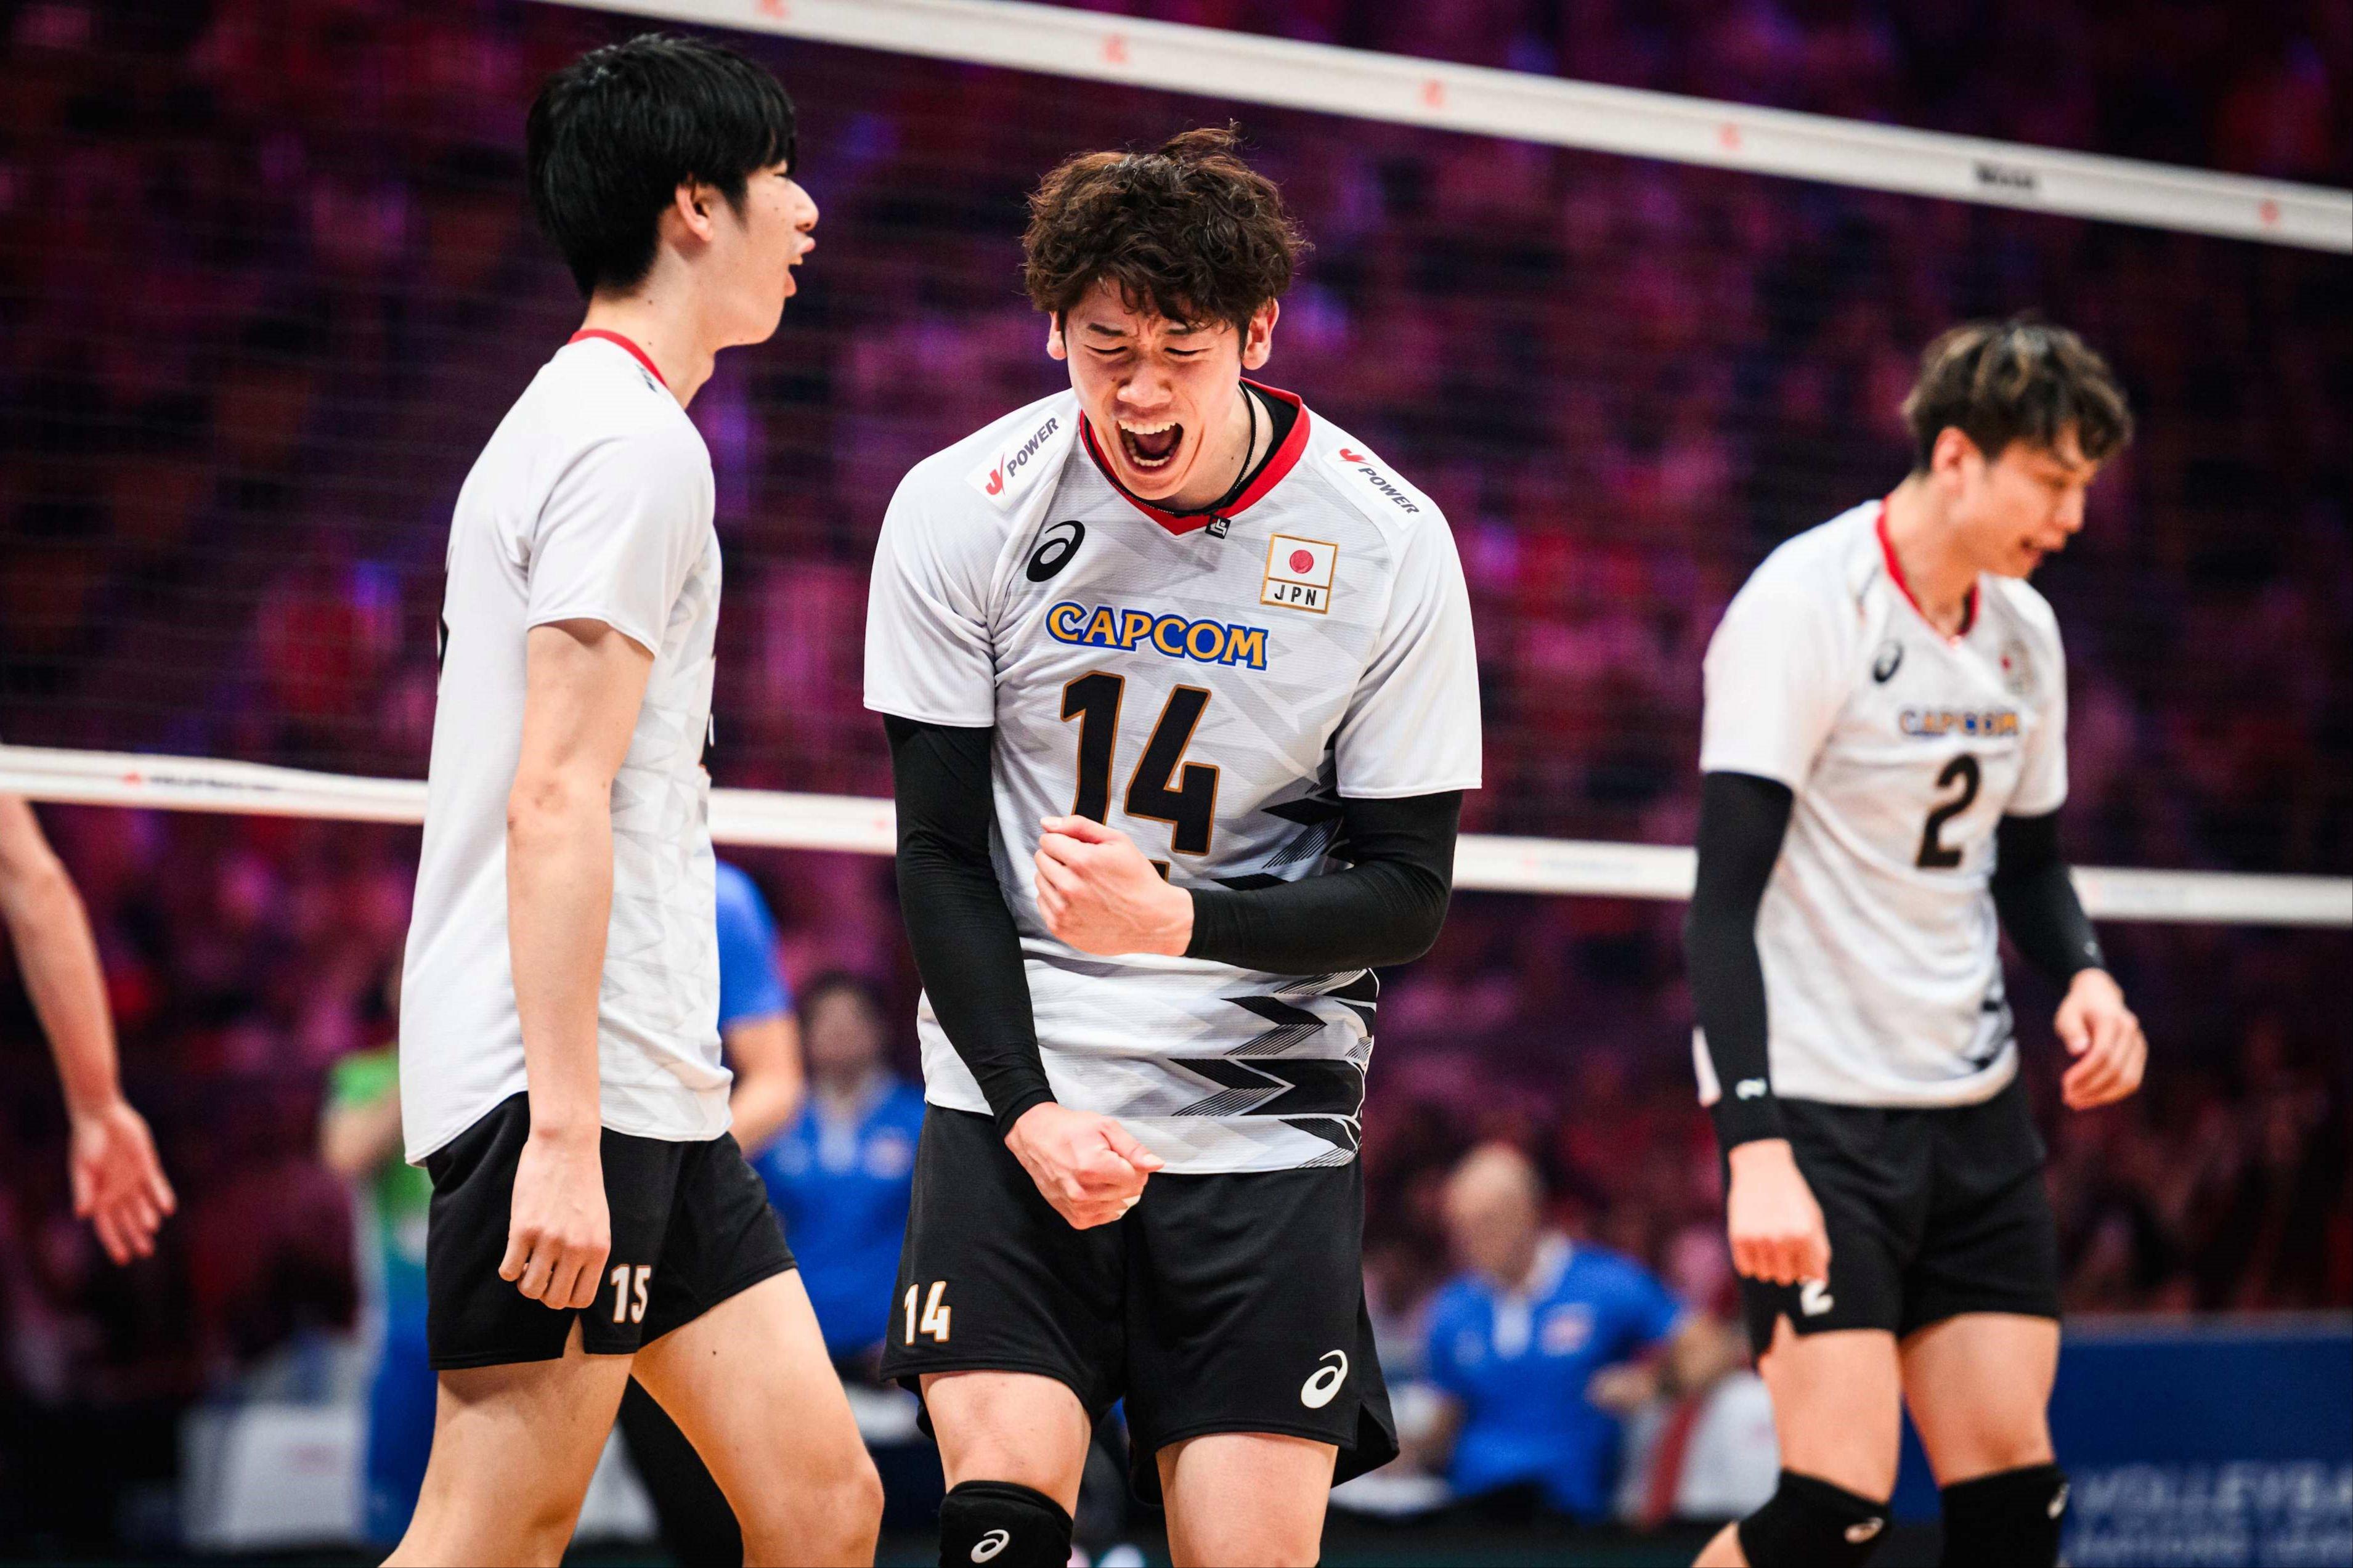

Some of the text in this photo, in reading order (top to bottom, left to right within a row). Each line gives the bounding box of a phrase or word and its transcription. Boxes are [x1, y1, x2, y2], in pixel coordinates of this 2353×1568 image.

[1007, 417, 1059, 477] POWER
[1358, 467, 1419, 514] POWER
[1275, 585, 1317, 606] JPN
[1047, 601, 1269, 670] CAPCOM
[1899, 710, 2019, 736] CAPCOM
[1060, 670, 1219, 856] 14
[1916, 754, 1980, 868] 2
[610, 1264, 651, 1323] 15
[904, 1282, 950, 1345] 14
